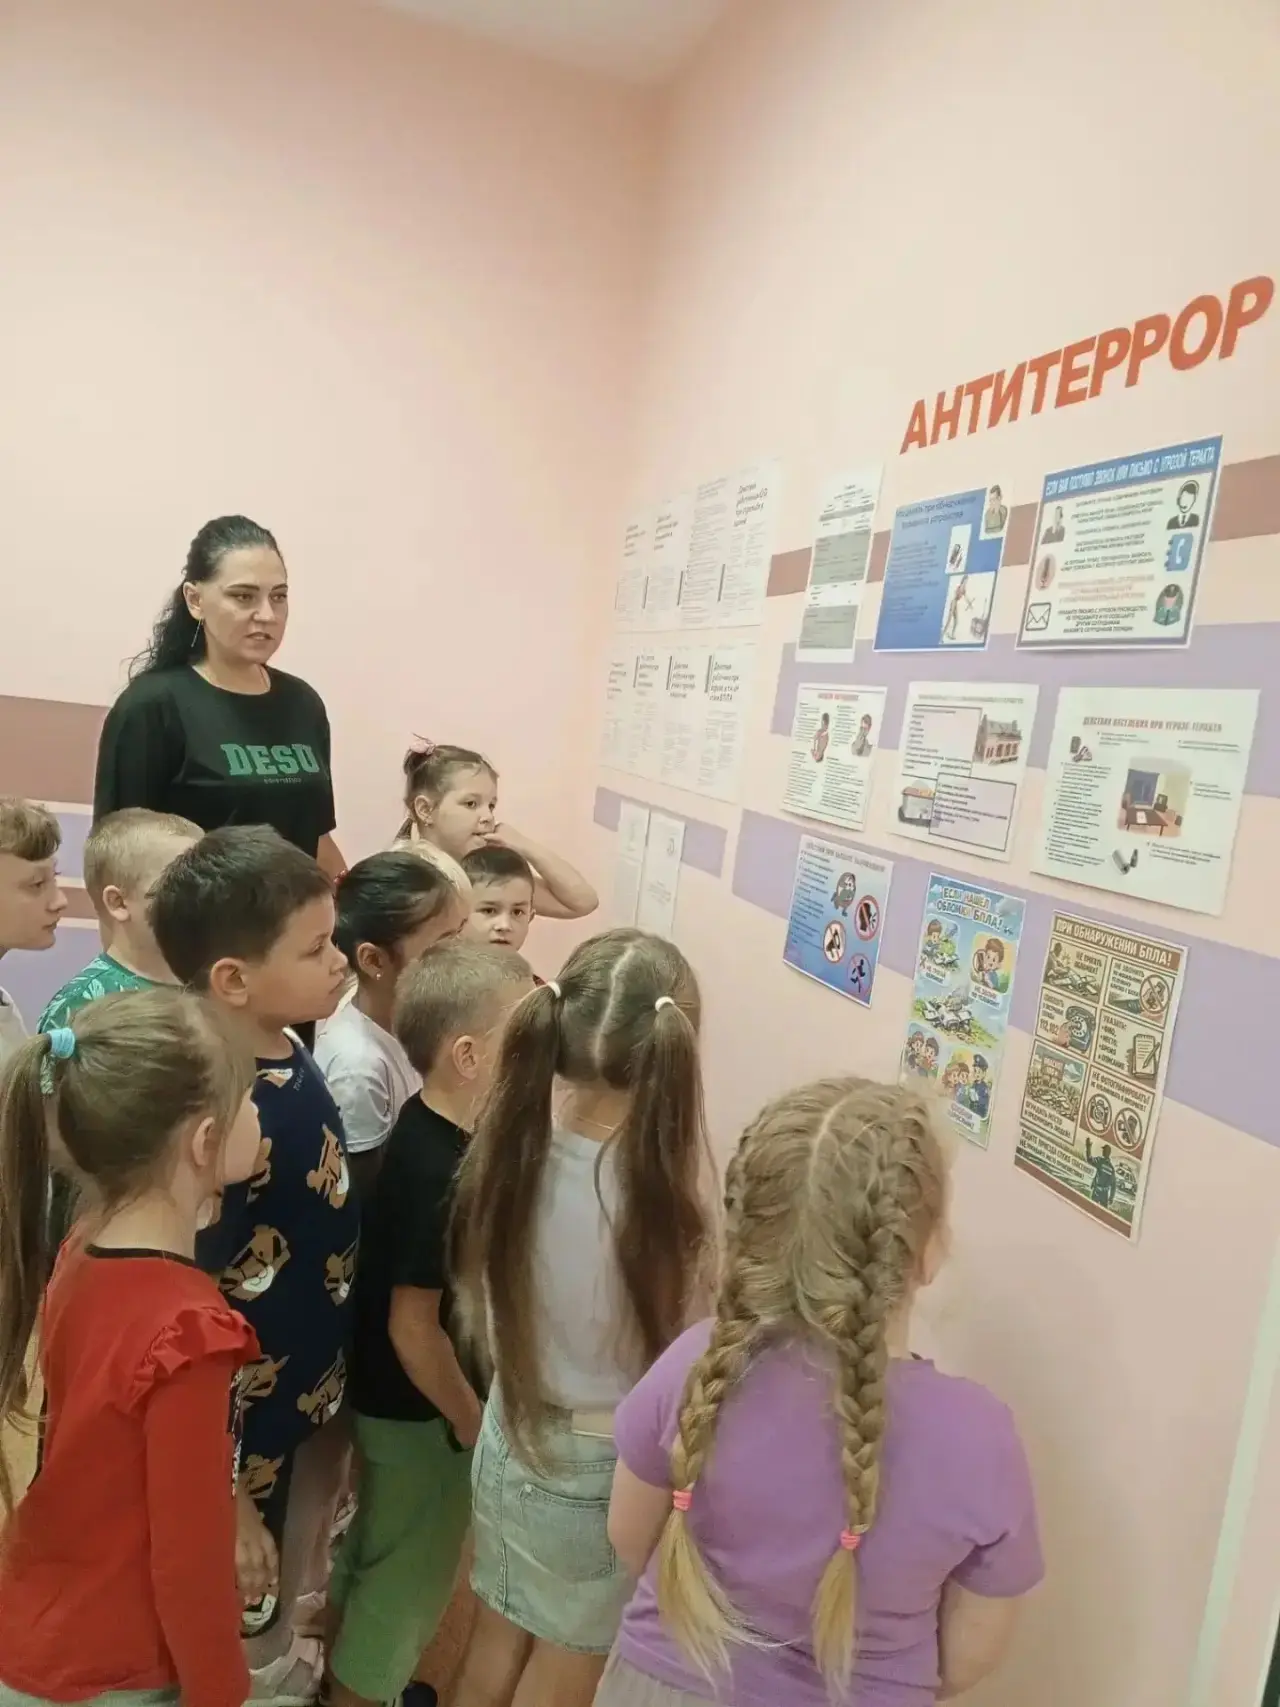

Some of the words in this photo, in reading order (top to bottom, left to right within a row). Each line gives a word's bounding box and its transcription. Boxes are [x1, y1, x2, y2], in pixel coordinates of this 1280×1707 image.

[899, 275, 1275, 456] АНТИТЕРРОР
[1149, 720, 1164, 729] ПРИ
[1055, 919, 1073, 935] ПРИ
[1072, 924, 1138, 955] ОБНАРУЖЕНИИ
[1137, 944, 1172, 966] БПЛА!
